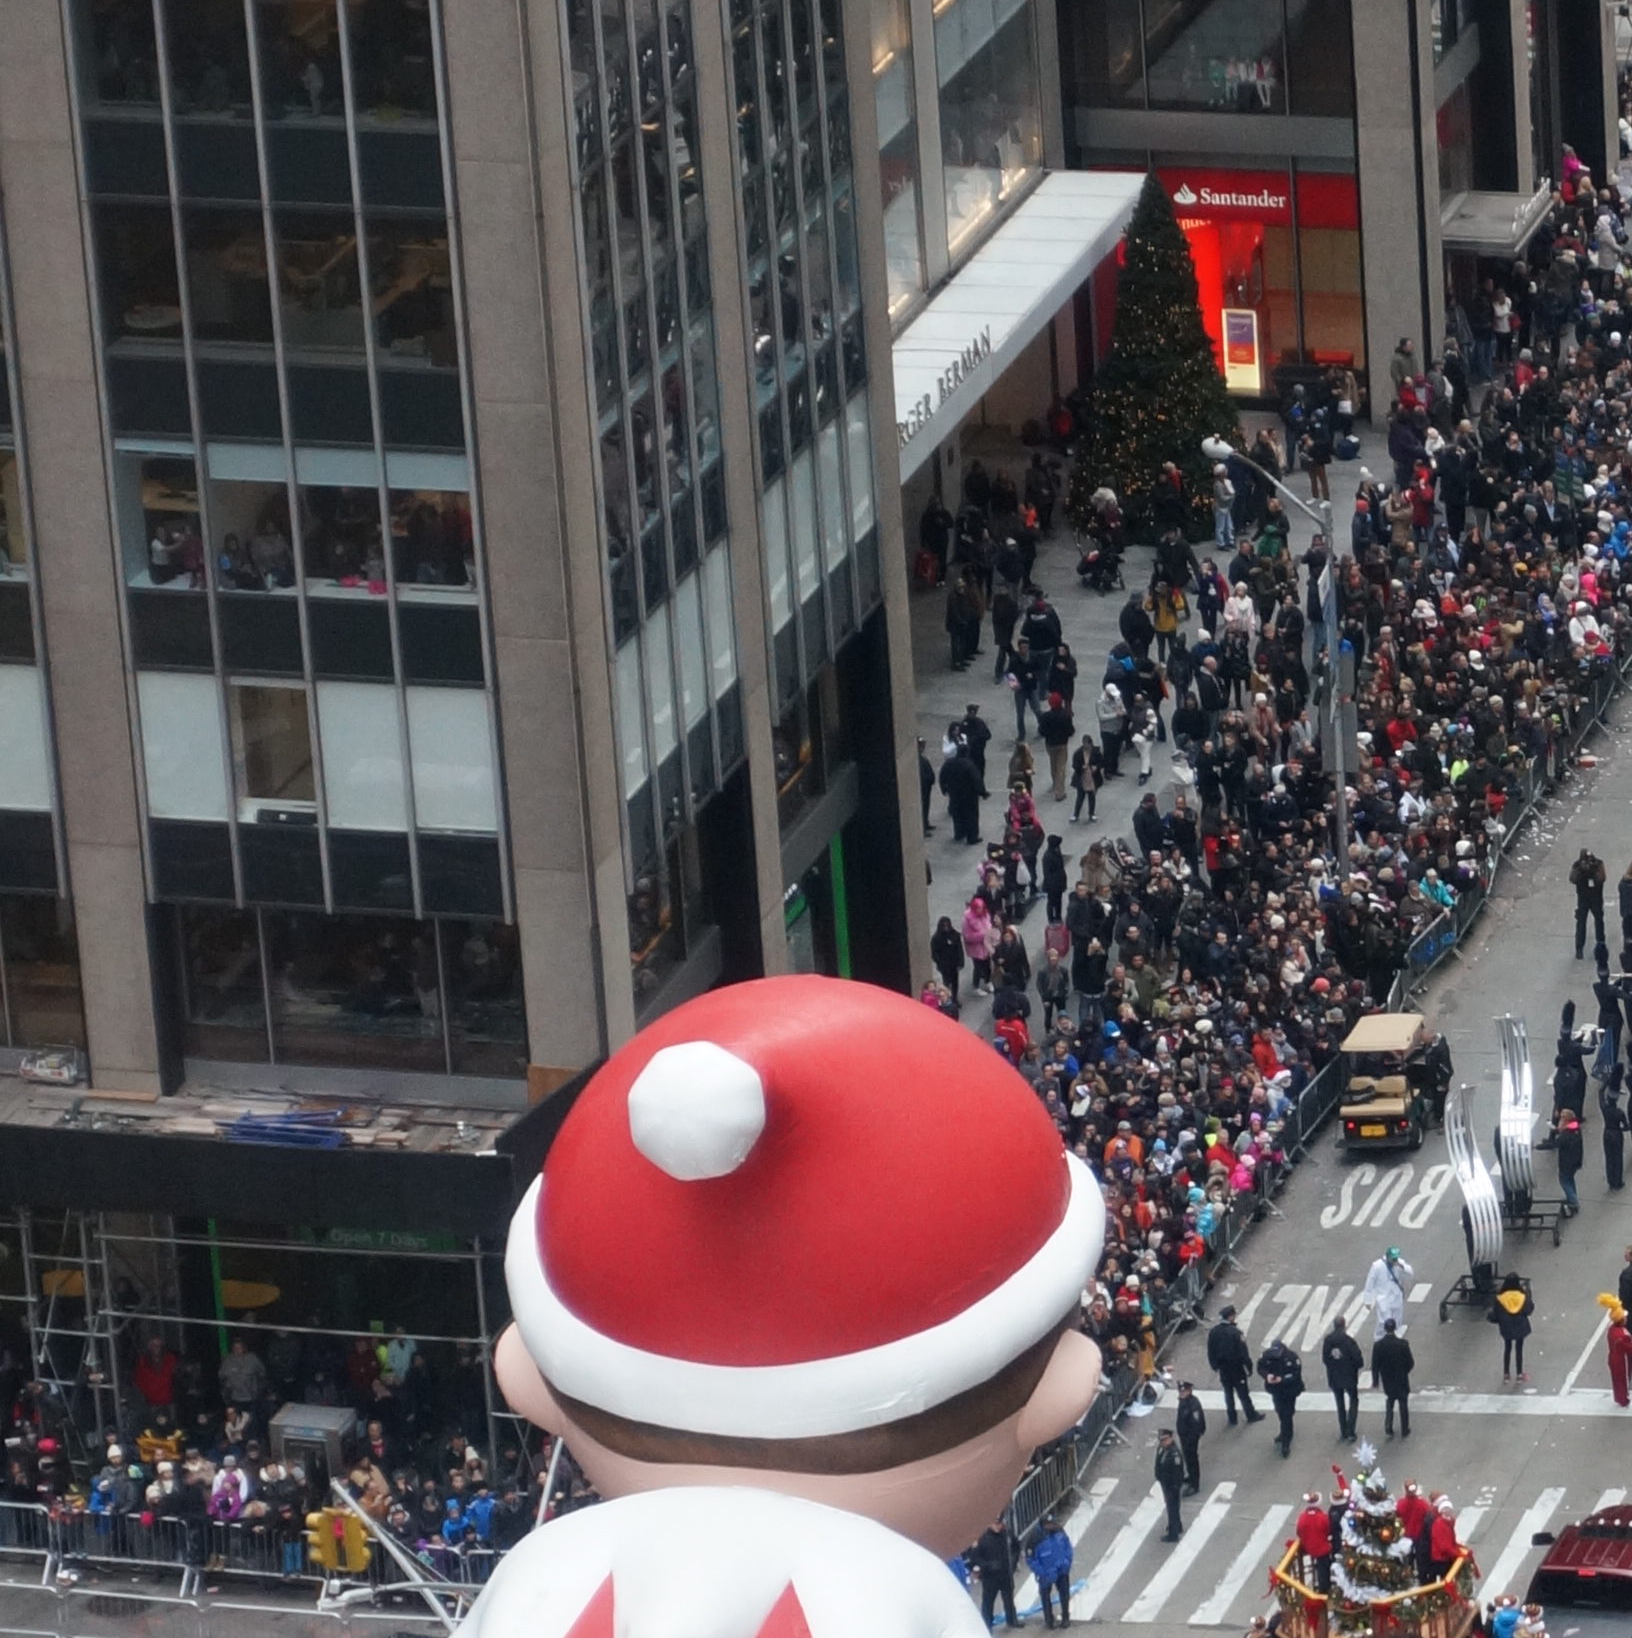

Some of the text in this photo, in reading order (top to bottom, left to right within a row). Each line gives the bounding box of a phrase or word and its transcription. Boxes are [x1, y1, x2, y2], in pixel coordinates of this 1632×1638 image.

[1200, 188, 1286, 207] Santander
[937, 324, 991, 405] BERMAN
[1320, 1164, 1453, 1230] BUS
